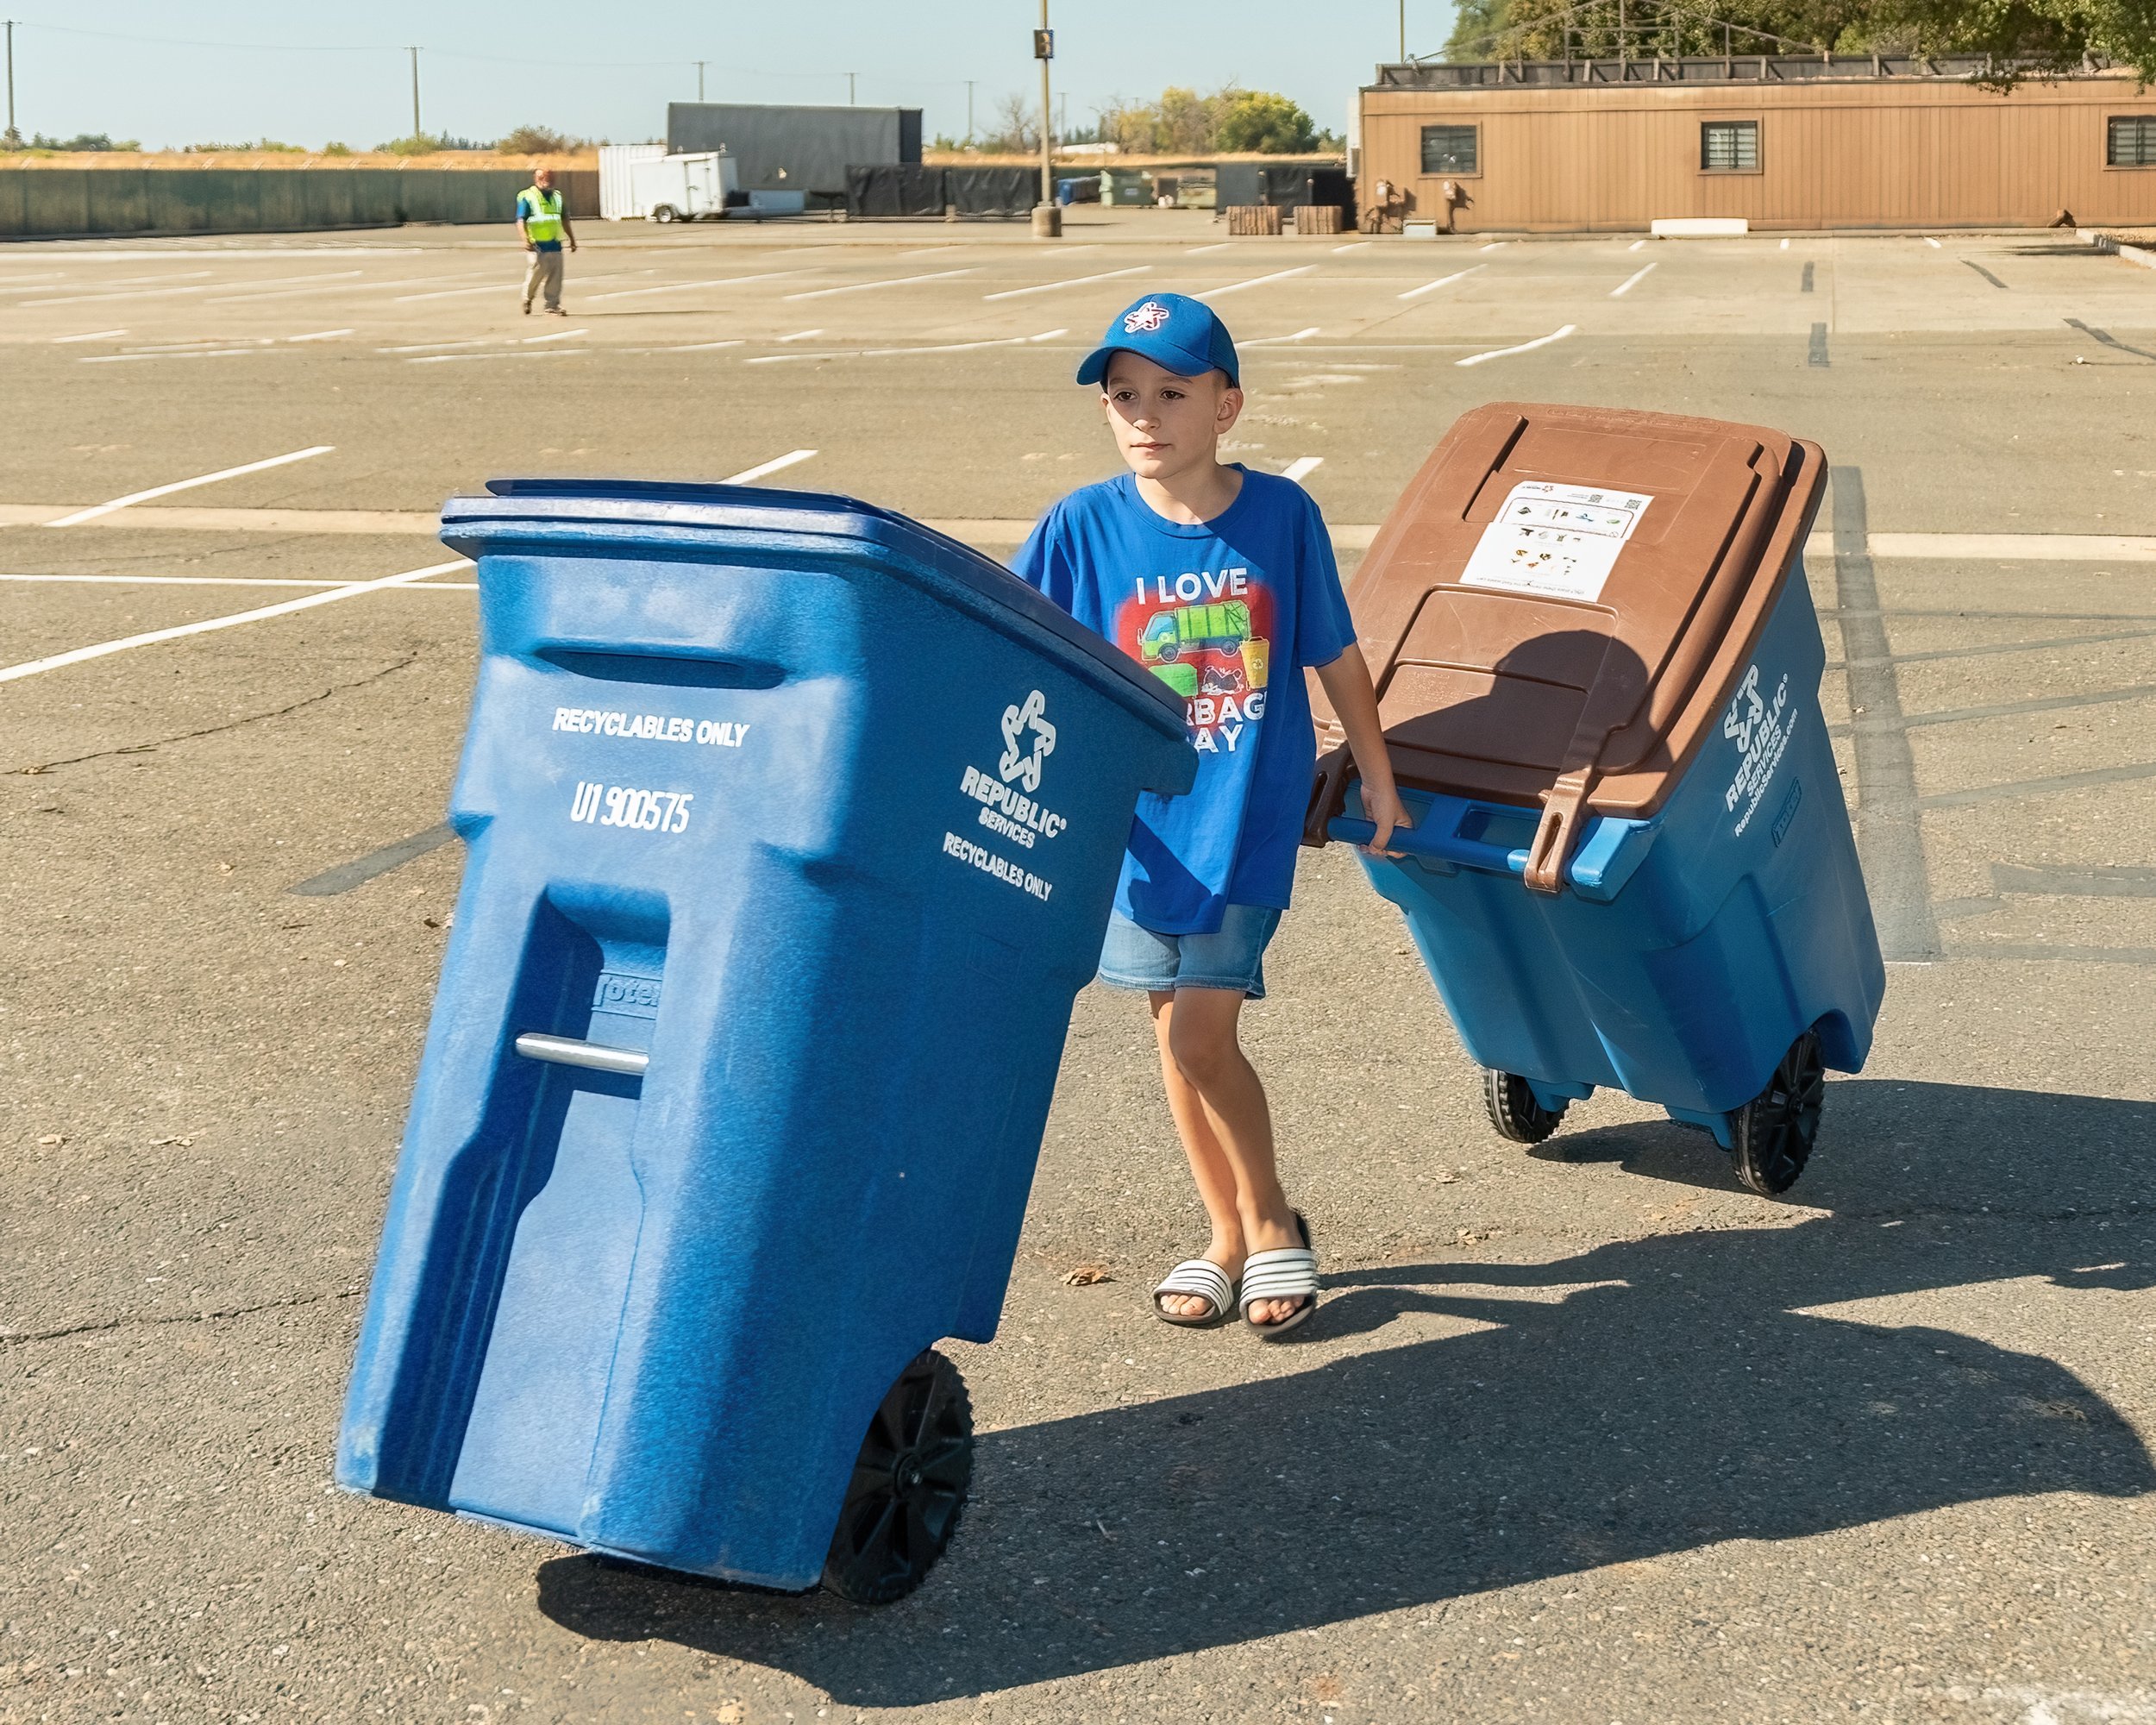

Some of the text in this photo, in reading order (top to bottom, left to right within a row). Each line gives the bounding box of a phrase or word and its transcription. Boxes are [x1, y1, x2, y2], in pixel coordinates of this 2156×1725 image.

[1136, 568, 1248, 605] I LOVE
[553, 707, 750, 747] RECYCLABLES ONLY
[1186, 724, 1243, 753] AY
[1734, 708, 1798, 837] RepublicServices.com
[1746, 724, 1782, 797] SERVICES
[600, 787, 694, 833] 900575
[978, 806, 1035, 849] SERVICES
[943, 831, 1052, 901] RECYCLABLES ONLY
